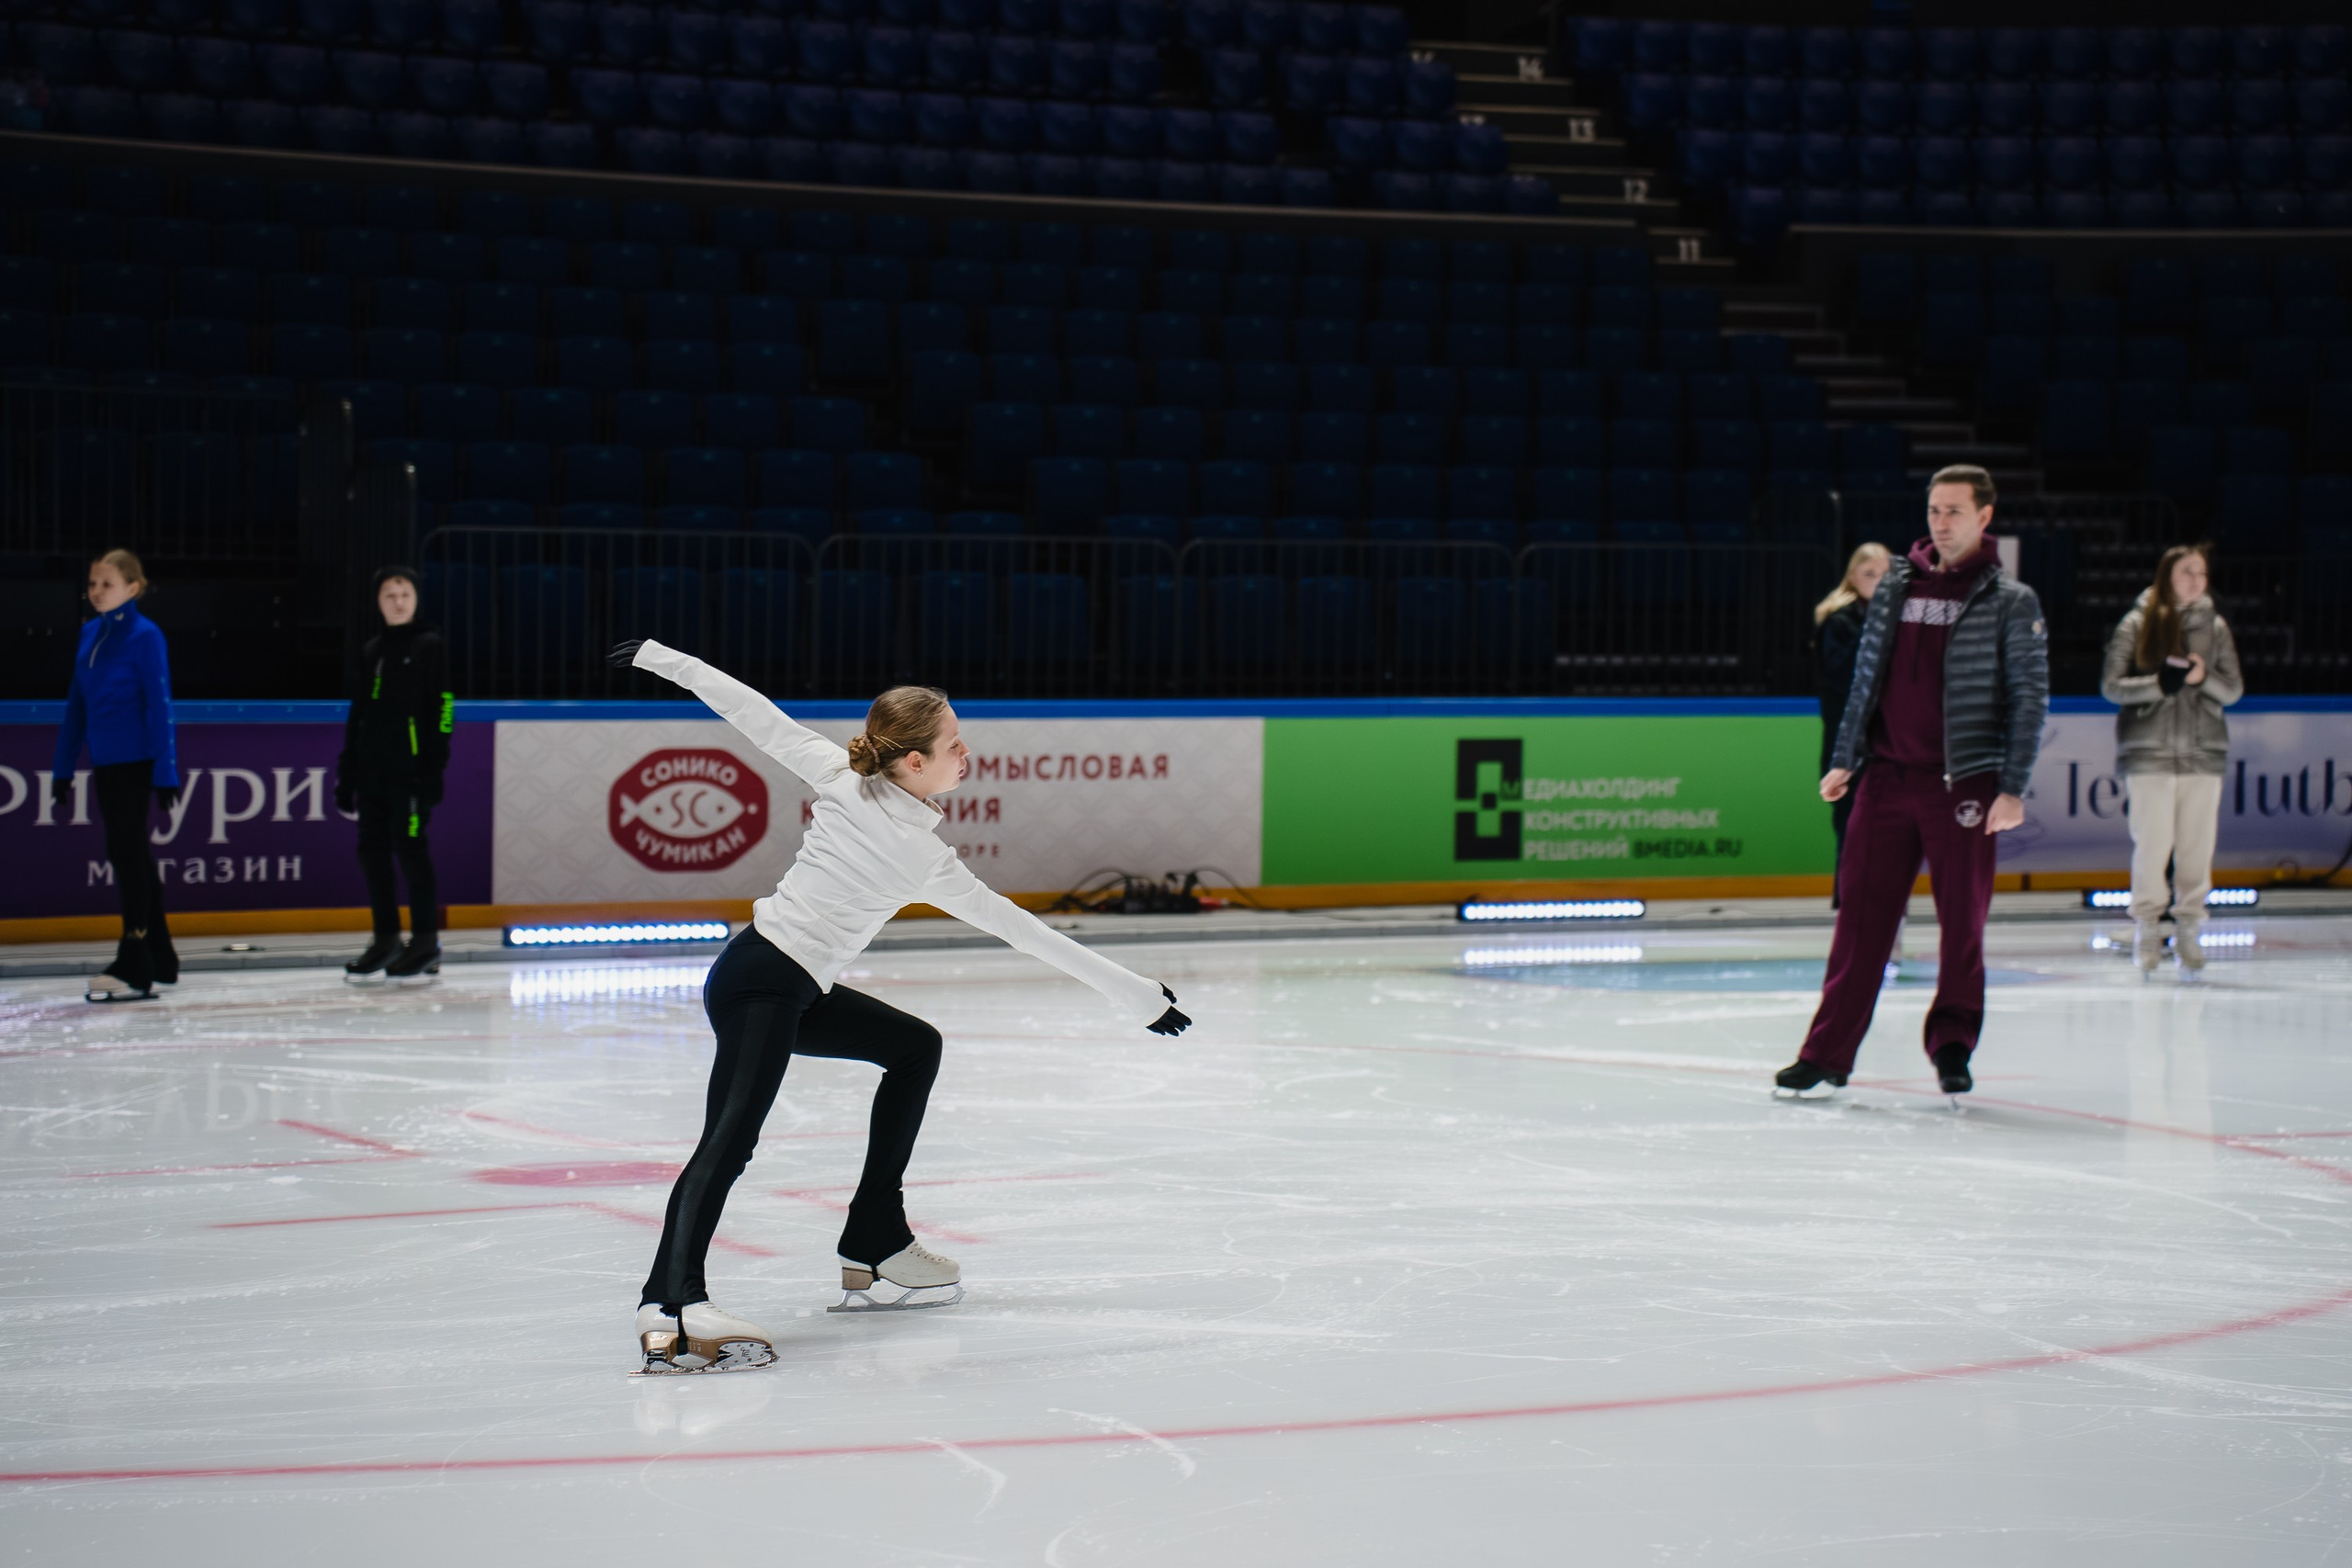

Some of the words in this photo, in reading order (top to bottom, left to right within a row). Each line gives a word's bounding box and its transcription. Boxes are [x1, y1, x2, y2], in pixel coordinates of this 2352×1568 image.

[1623, 177, 1649, 204] 12
[1678, 236, 1702, 264] 11
[640, 755, 739, 788] СОНИКО
[964, 754, 1170, 781] МЫСЛОВАЯ
[1501, 776, 1681, 803] МЕДИАХОЛДИНГ
[0, 766, 360, 845] иури
[1523, 808, 1720, 831] КОНСТРУКТИВНЫХ
[635, 826, 747, 864] ЧУМИКАН
[958, 842, 1001, 859] ОРЕ
[1523, 834, 1630, 862] РЕШЕНИЙ
[87, 855, 302, 886] мгазин
